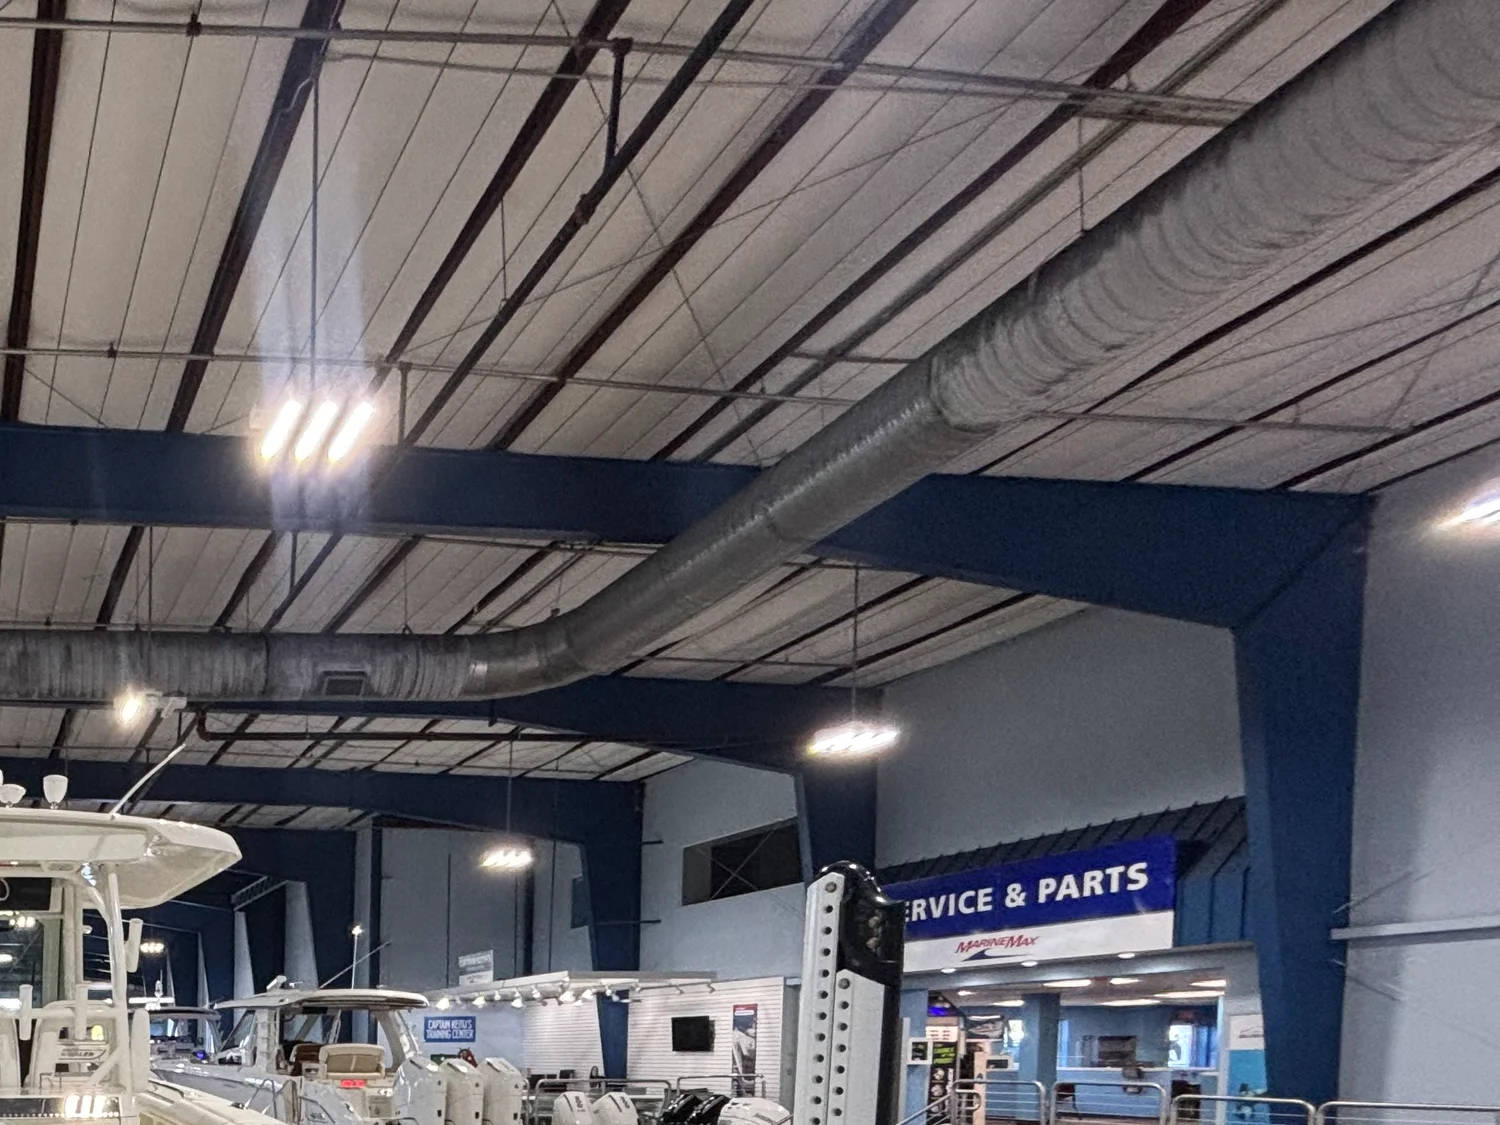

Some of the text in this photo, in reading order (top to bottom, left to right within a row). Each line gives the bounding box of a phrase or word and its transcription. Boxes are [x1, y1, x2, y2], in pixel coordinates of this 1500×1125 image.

[903, 861, 1149, 923] RVICE & PARTS
